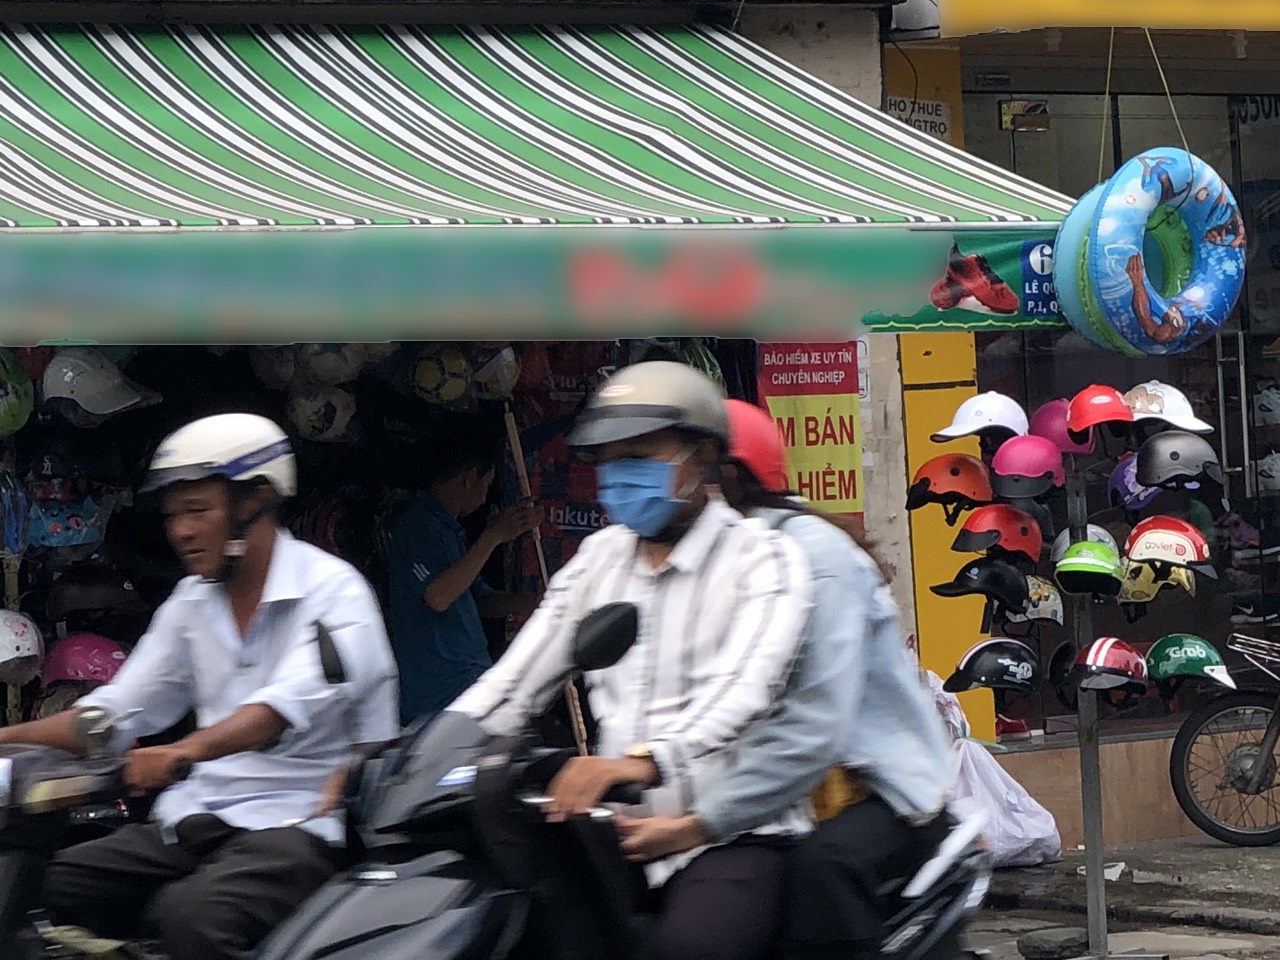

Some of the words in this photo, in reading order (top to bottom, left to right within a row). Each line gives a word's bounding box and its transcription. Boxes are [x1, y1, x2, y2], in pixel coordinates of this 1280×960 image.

[1025, 279, 1039, 294] LÊ
[764, 351, 783, 366] BẢO
[810, 352, 822, 364] XE
[823, 352, 835, 364] UY
[837, 348, 852, 364] TÍN
[772, 370, 811, 385] CHUYÊN
[804, 407, 855, 447] BÁN
[797, 462, 857, 502] HIỂM
[1168, 646, 1206, 659] Grab
